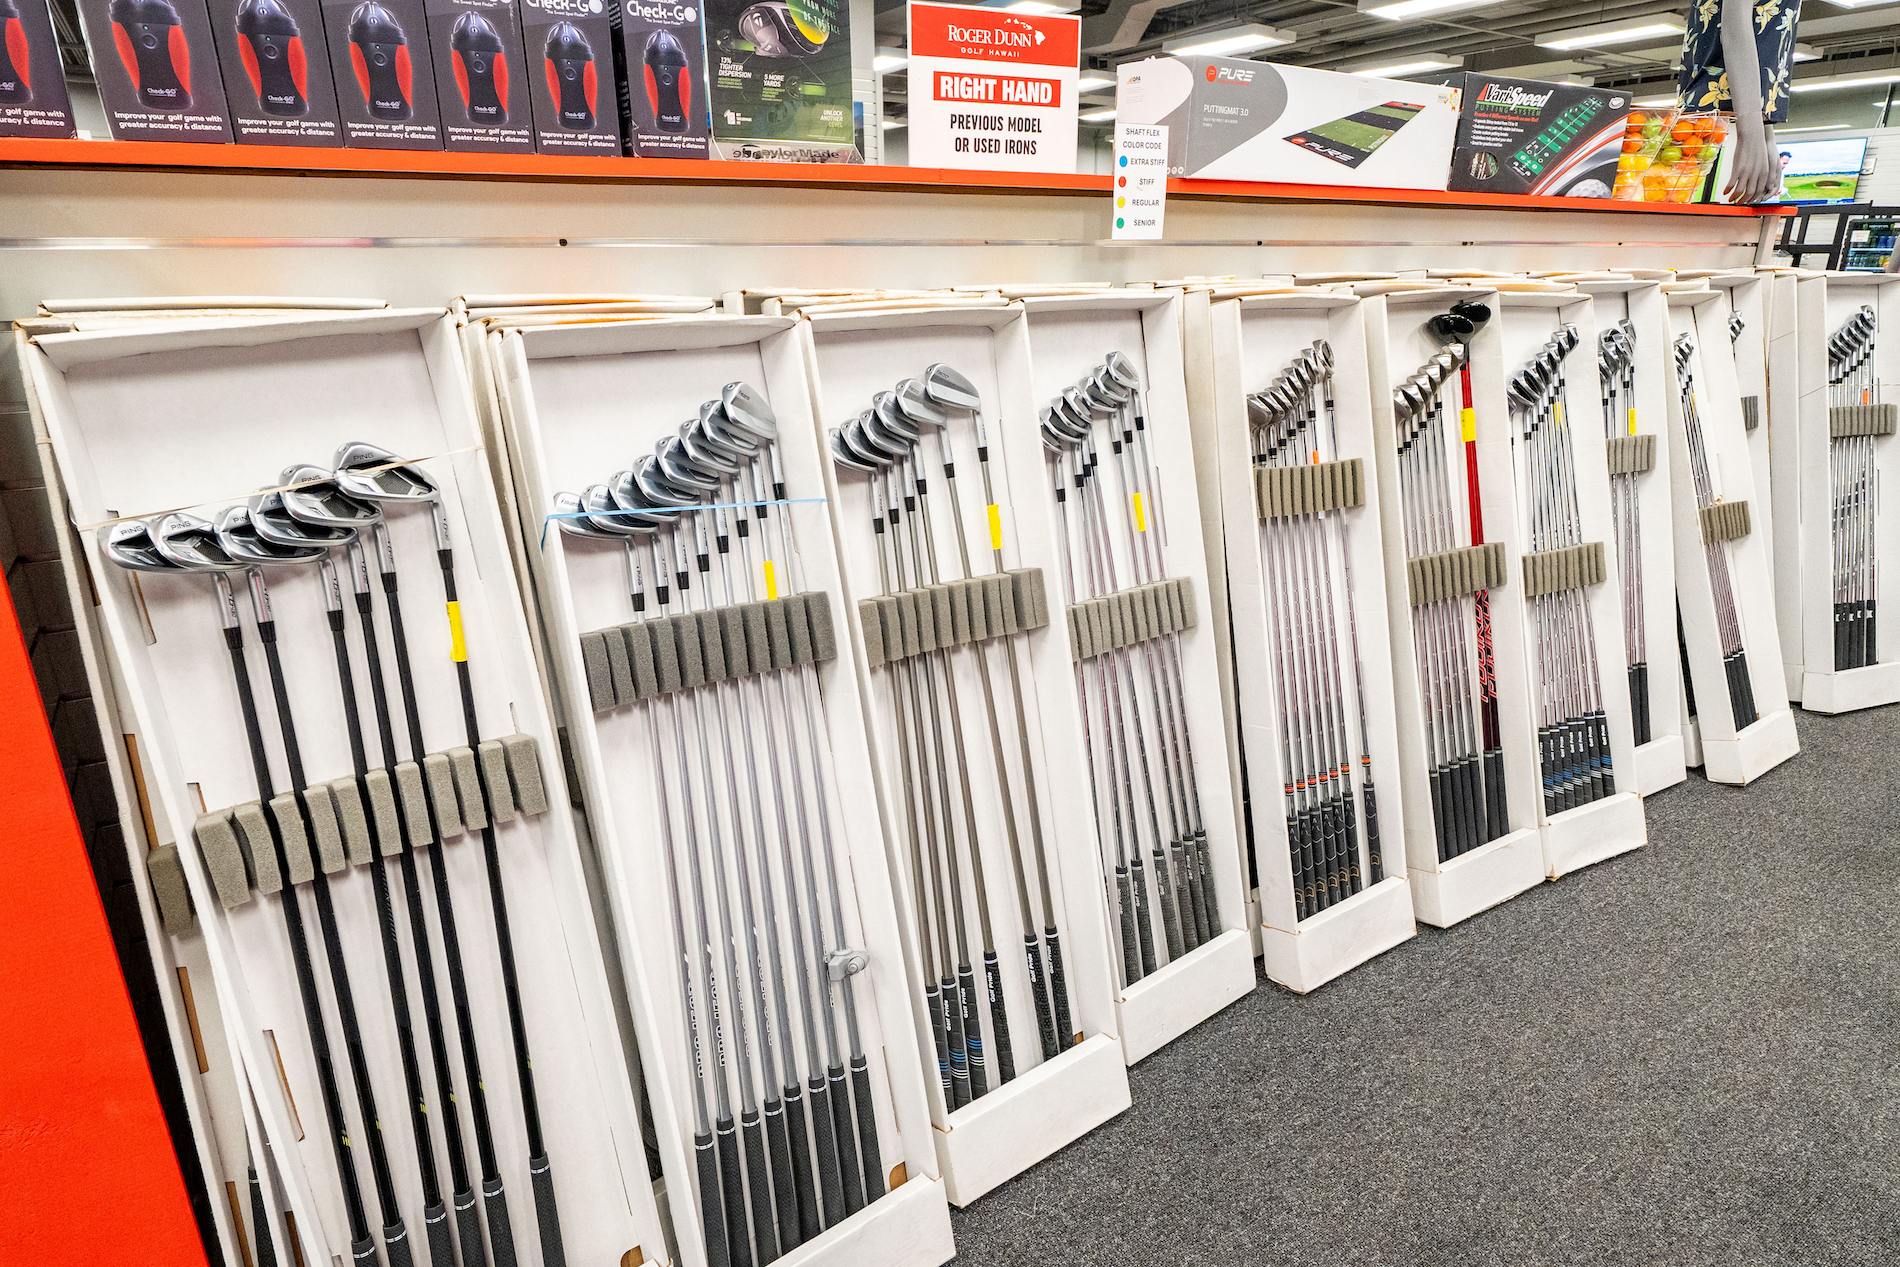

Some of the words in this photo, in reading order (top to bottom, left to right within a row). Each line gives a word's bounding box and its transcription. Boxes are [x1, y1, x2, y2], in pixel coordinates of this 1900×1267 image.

[947, 24, 993, 45] ROGER
[994, 28, 1032, 48] DUNN
[960, 46, 985, 56] GOLF
[988, 49, 1020, 58] HAWAII
[720, 63, 744, 71] TIGHTER
[718, 70, 752, 79] DISPERSION
[769, 74, 785, 82] MORE
[1218, 67, 1256, 83] PURE
[940, 75, 998, 101] RIGHT
[1002, 79, 1053, 104] HAND
[1484, 83, 1555, 111] VariSpeed
[5, 108, 22, 117] golf
[22, 109, 46, 118] game
[46, 110, 66, 118] with
[1203, 104, 1239, 117] PUTTINGMAT
[1239, 108, 1250, 117] 3.0
[1474, 103, 1509, 114] PUTTING
[1514, 107, 1541, 117] SYSTEM
[114, 111, 147, 120] Improve
[147, 114, 165, 122] your
[168, 114, 183, 122] golf
[183, 115, 205, 123] game
[205, 115, 223, 123] with
[237, 117, 267, 126] Improve
[30, 118, 66, 127] distance
[149, 123, 184, 131] accuracy
[347, 121, 375, 130] Improve
[404, 124, 422, 132] game
[950, 113, 1004, 131] PREVIOUS
[1007, 116, 1042, 133] MODEL
[268, 128, 300, 136] accuracy
[1126, 127, 1146, 136] SHAFT
[1146, 129, 1161, 137] FLEX
[955, 136, 970, 153] OR
[973, 137, 1001, 154] USED
[1004, 139, 1037, 155] IRONS
[1122, 140, 1145, 149] COLOR
[1145, 142, 1162, 150] CODE
[1305, 141, 1355, 162] PURE
[1130, 158, 1150, 166] EXTRA
[1150, 158, 1165, 166] STIFF
[1139, 178, 1155, 186] STIFF
[1133, 219, 1156, 227] SENIOR
[353, 452, 375, 462] PING
[301, 474, 322, 484] PING
[232, 516, 249, 524] PIN
[170, 520, 192, 531] PING
[120, 525, 144, 537] PING
